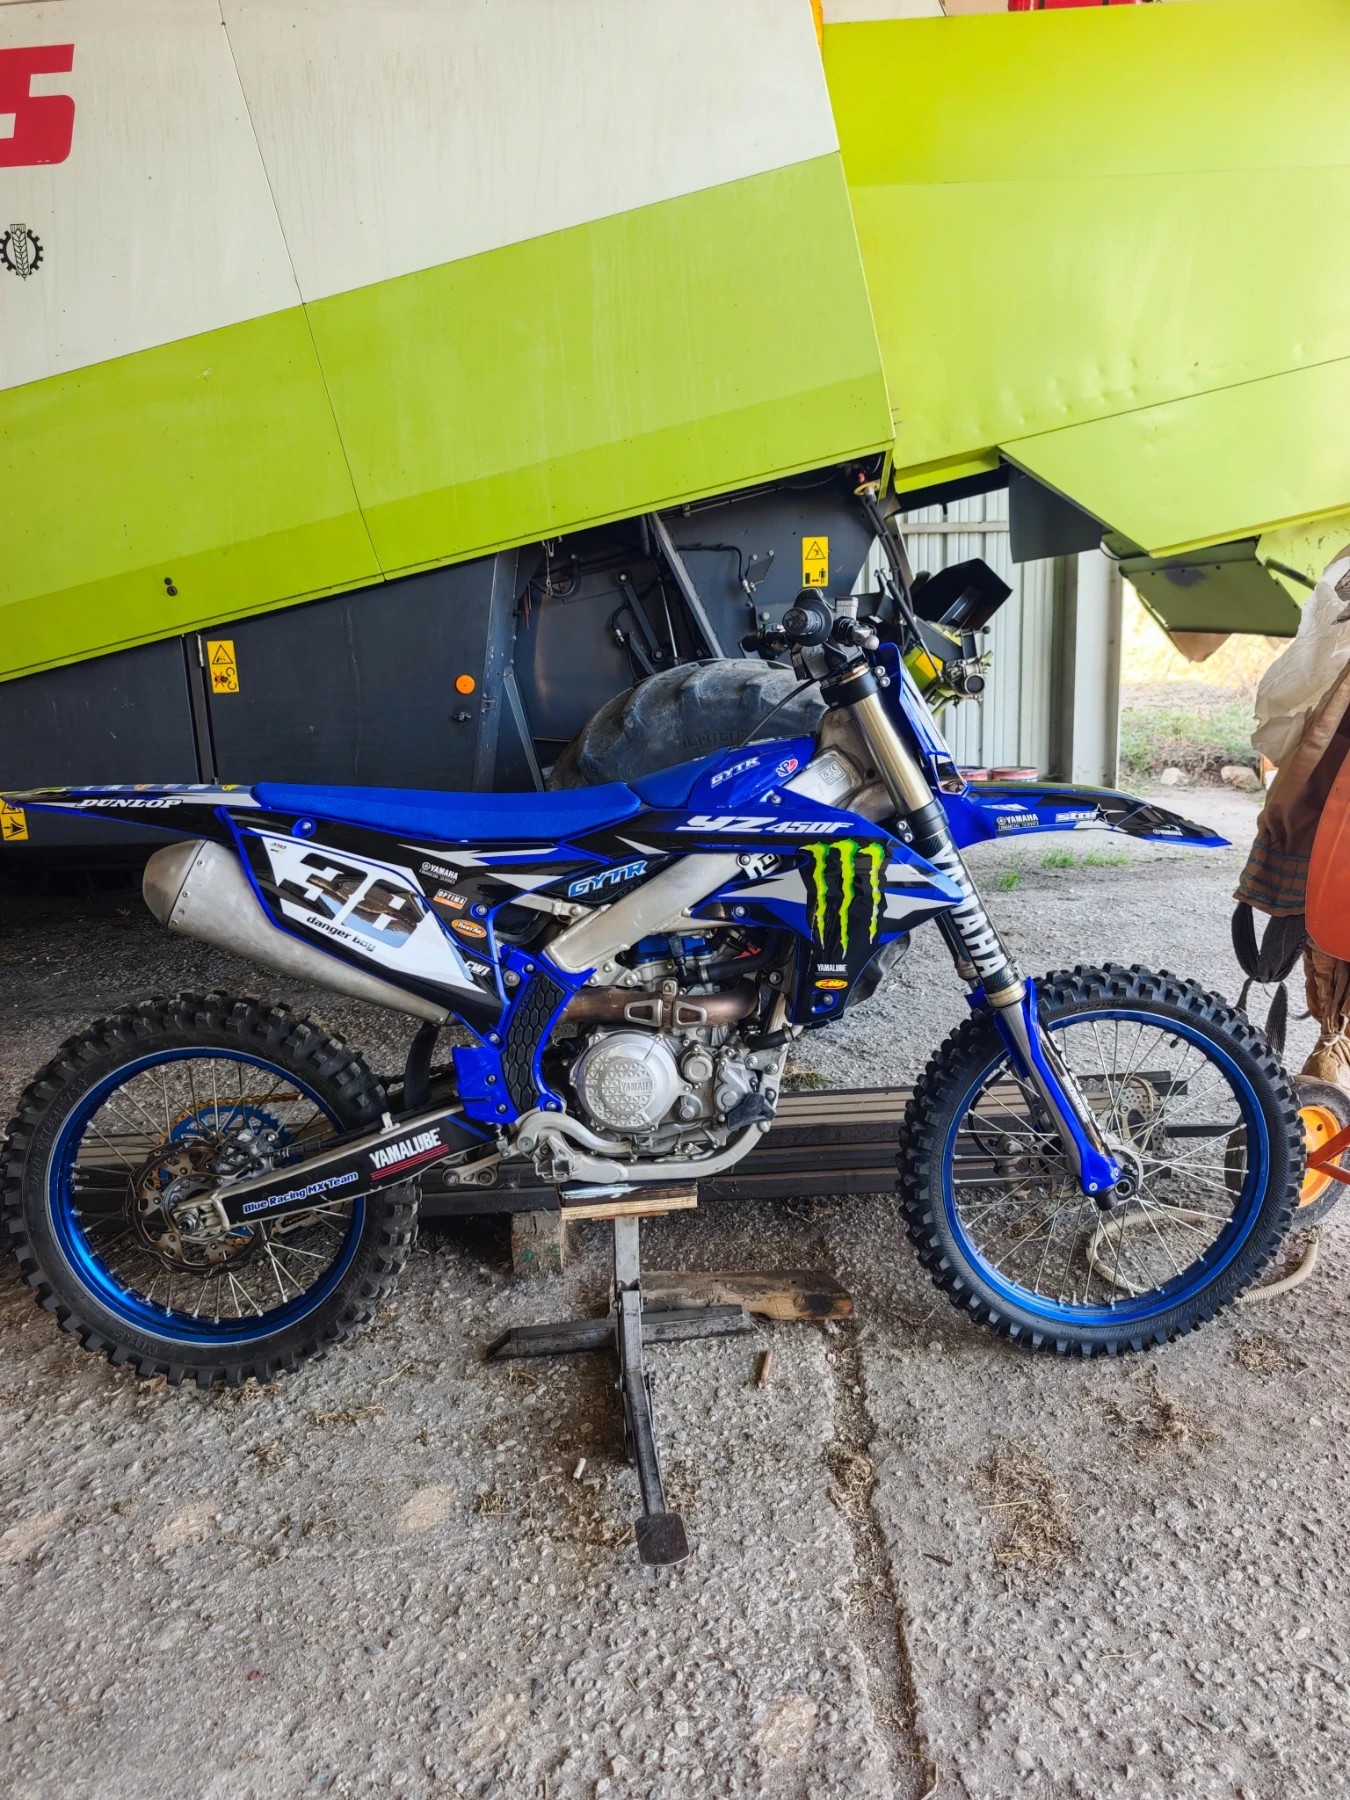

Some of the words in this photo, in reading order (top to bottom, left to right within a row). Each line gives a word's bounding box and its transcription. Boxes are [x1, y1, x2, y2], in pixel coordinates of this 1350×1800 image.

[711, 757, 761, 788] GYTR
[77, 799, 182, 809] DUNLOP
[1005, 813, 1039, 824] YAMAHA
[1160, 829, 1184, 837] YAMAHA
[430, 863, 459, 880] YAMAHA
[568, 860, 648, 898] GYTR
[438, 890, 466, 905] OPTIMA
[306, 915, 352, 940] danger
[816, 963, 848, 972] YAMALUBE
[243, 1199, 268, 1215] Blue
[268, 1189, 306, 1207] Racing
[306, 1183, 326, 1197] MX
[326, 1171, 359, 1190] Team
